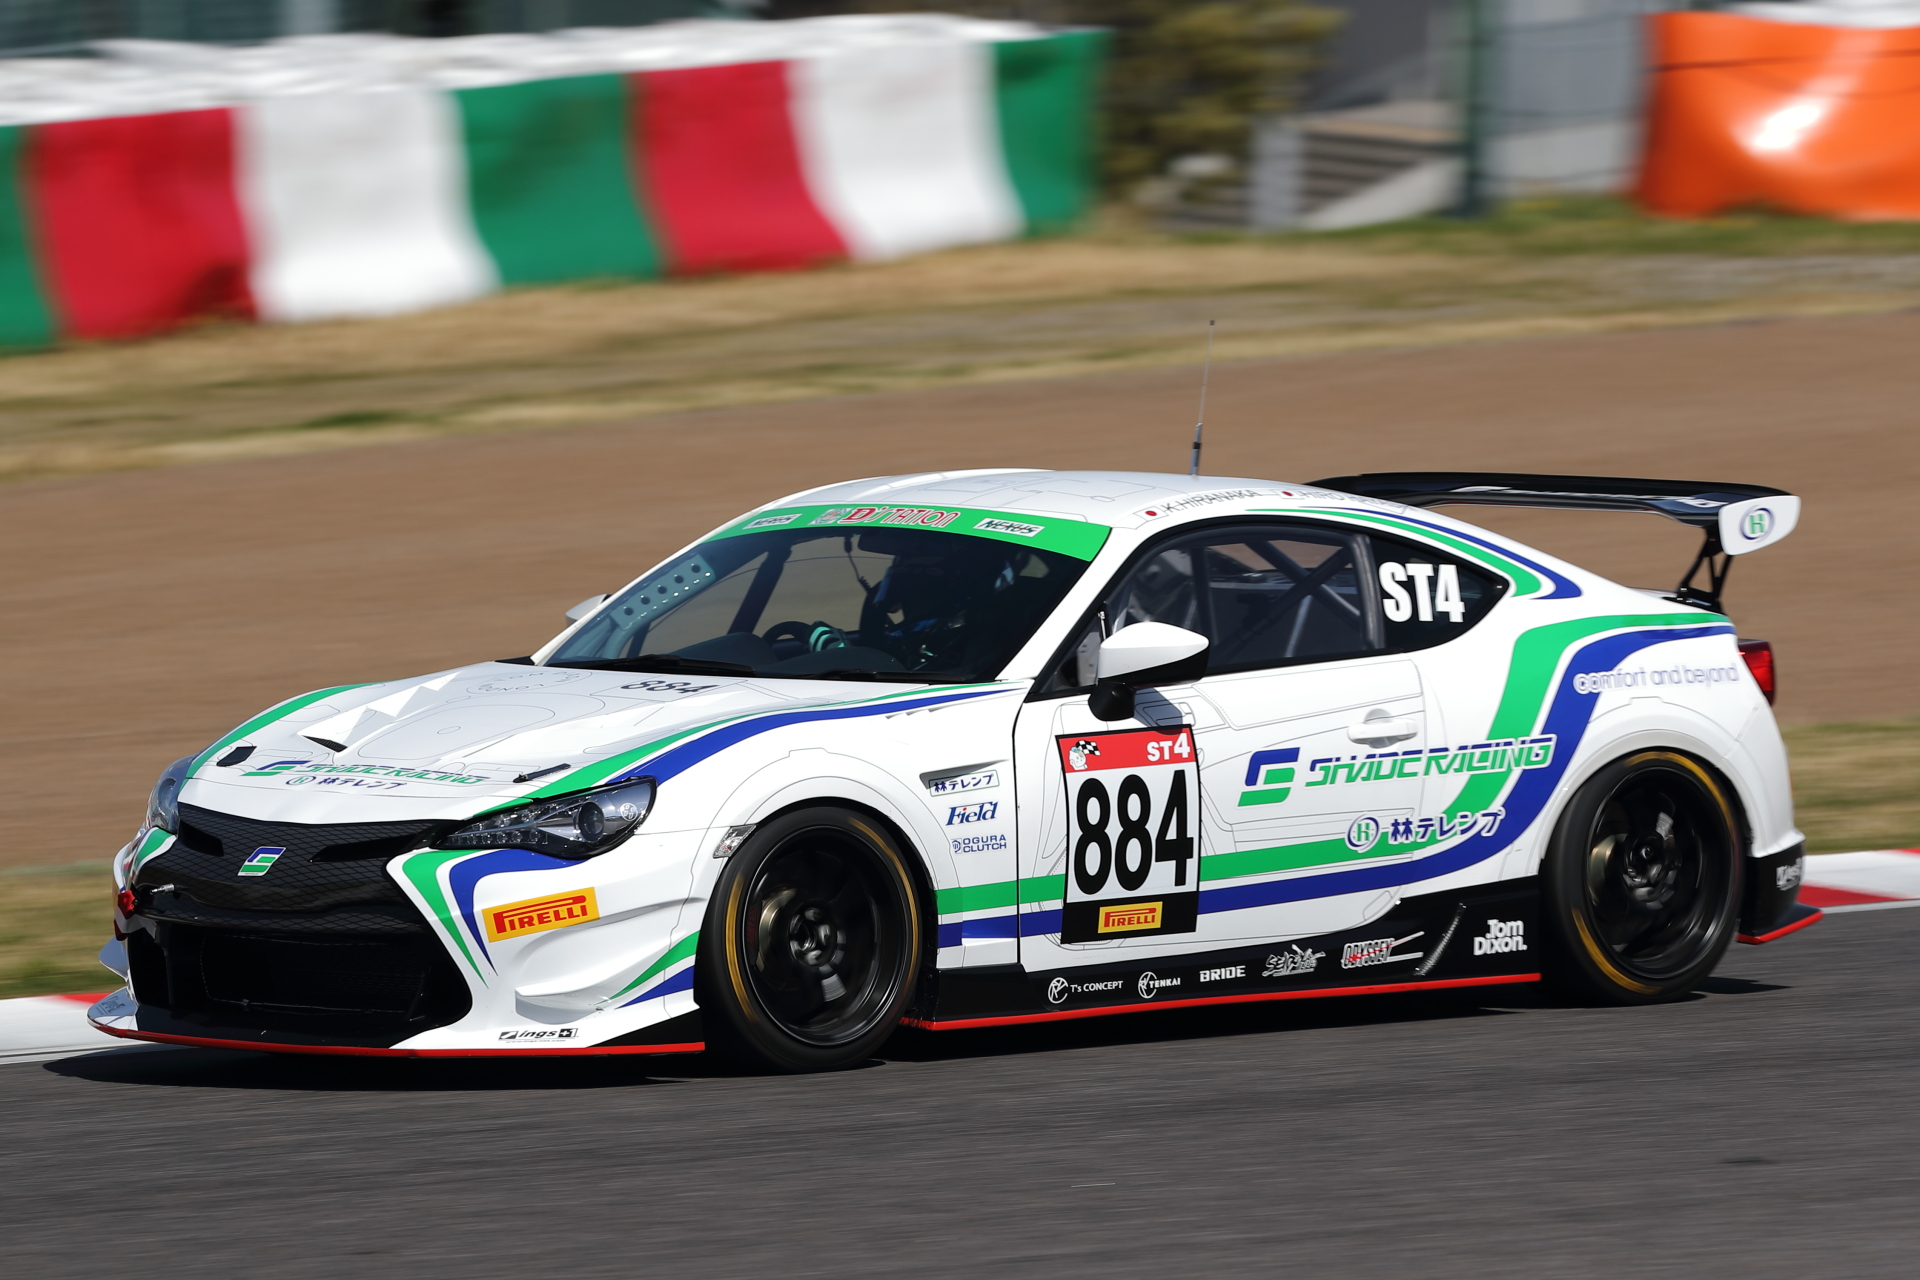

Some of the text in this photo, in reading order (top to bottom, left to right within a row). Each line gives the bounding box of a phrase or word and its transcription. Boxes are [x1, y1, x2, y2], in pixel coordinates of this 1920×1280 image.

[1160, 489, 1263, 513] K.HIRANAKA
[977, 520, 1041, 534] NEXUS
[1378, 561, 1466, 623] ST4
[620, 680, 721, 693] 884
[1576, 663, 1740, 694] comfort and beyond
[1146, 732, 1191, 762] ST4
[933, 772, 994, 793] 林テレンプ
[945, 801, 998, 826] Field
[1074, 769, 1194, 895] 884
[1389, 810, 1505, 843] 林テレンプ
[962, 834, 1006, 845] OGURA
[962, 842, 1007, 853] CLUTCH
[492, 895, 588, 934] PIRELLI
[1103, 907, 1156, 928] PIRELLI
[1486, 919, 1524, 938] Tom
[1149, 977, 1181, 988] TENKAI
[1199, 965, 1246, 983] BRIDE
[1070, 980, 1124, 992] T's CONCEPT
